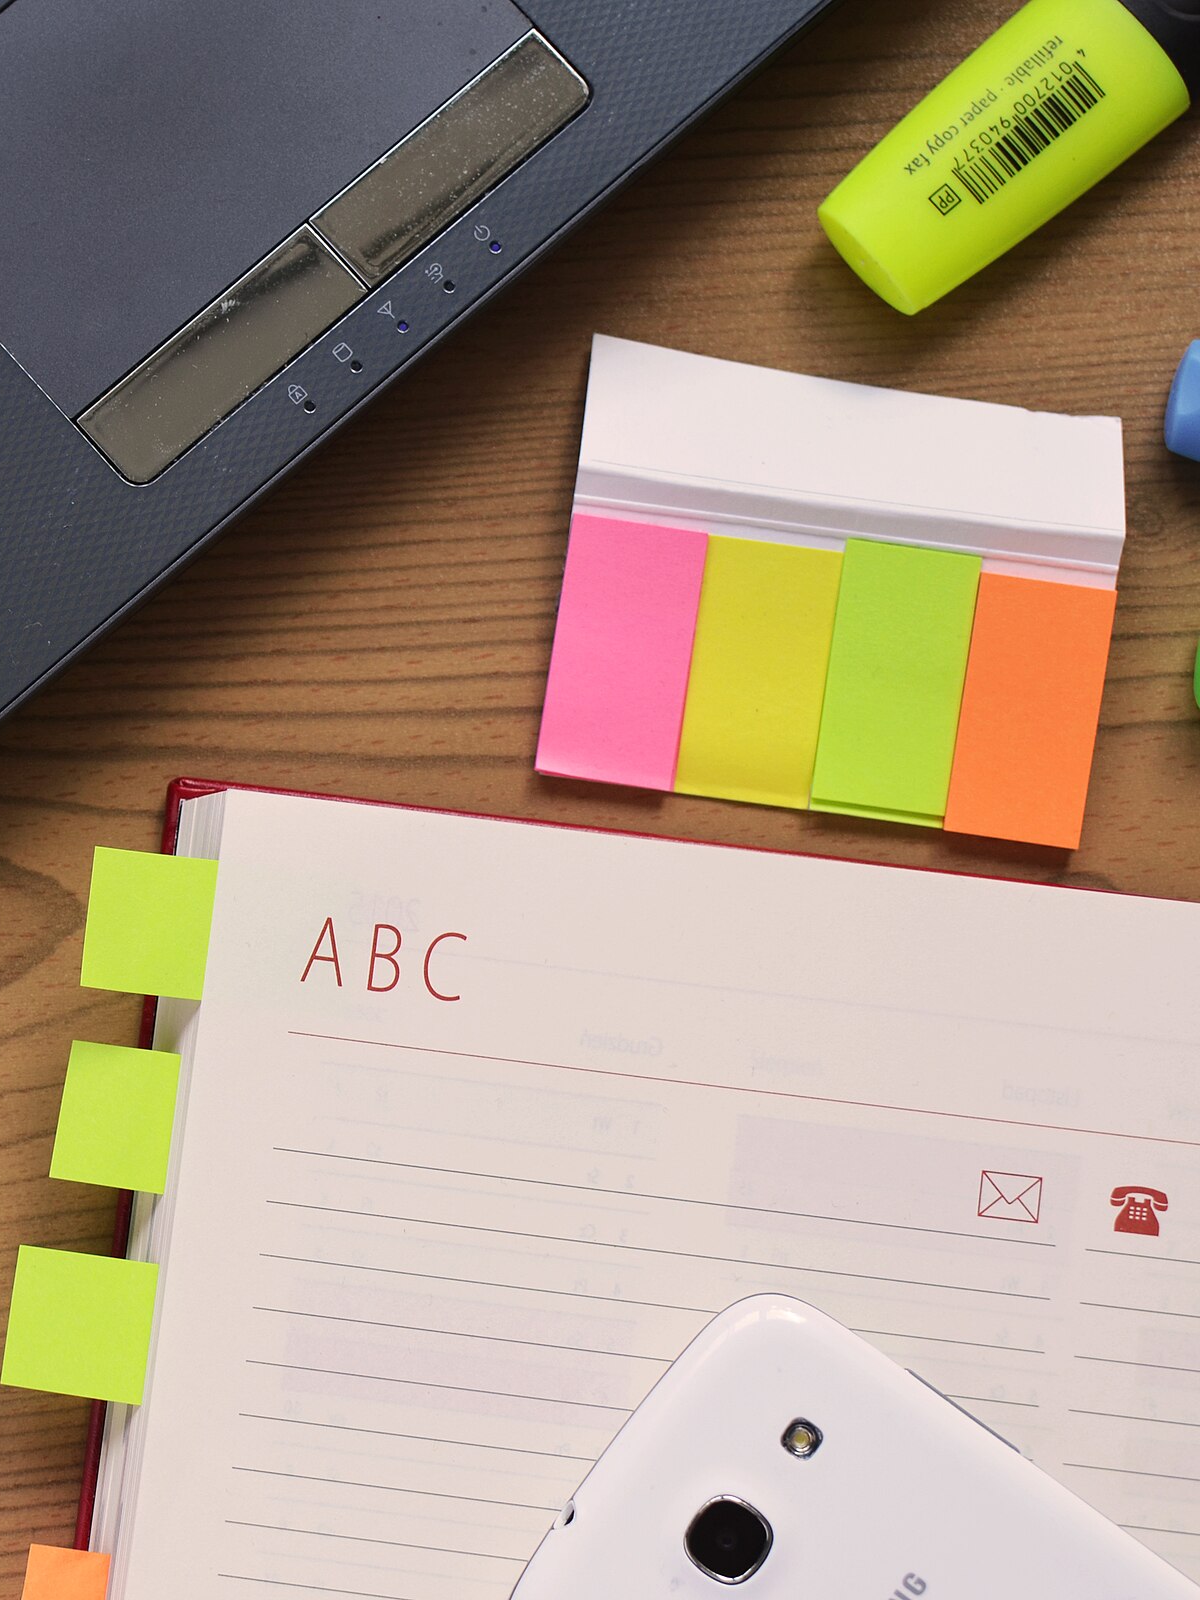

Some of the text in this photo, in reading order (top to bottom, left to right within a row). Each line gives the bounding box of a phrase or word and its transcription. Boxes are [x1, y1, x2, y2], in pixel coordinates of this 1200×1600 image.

[904, 35, 1064, 176] refillable paper copy fax
[300, 916, 468, 1002] ABC
